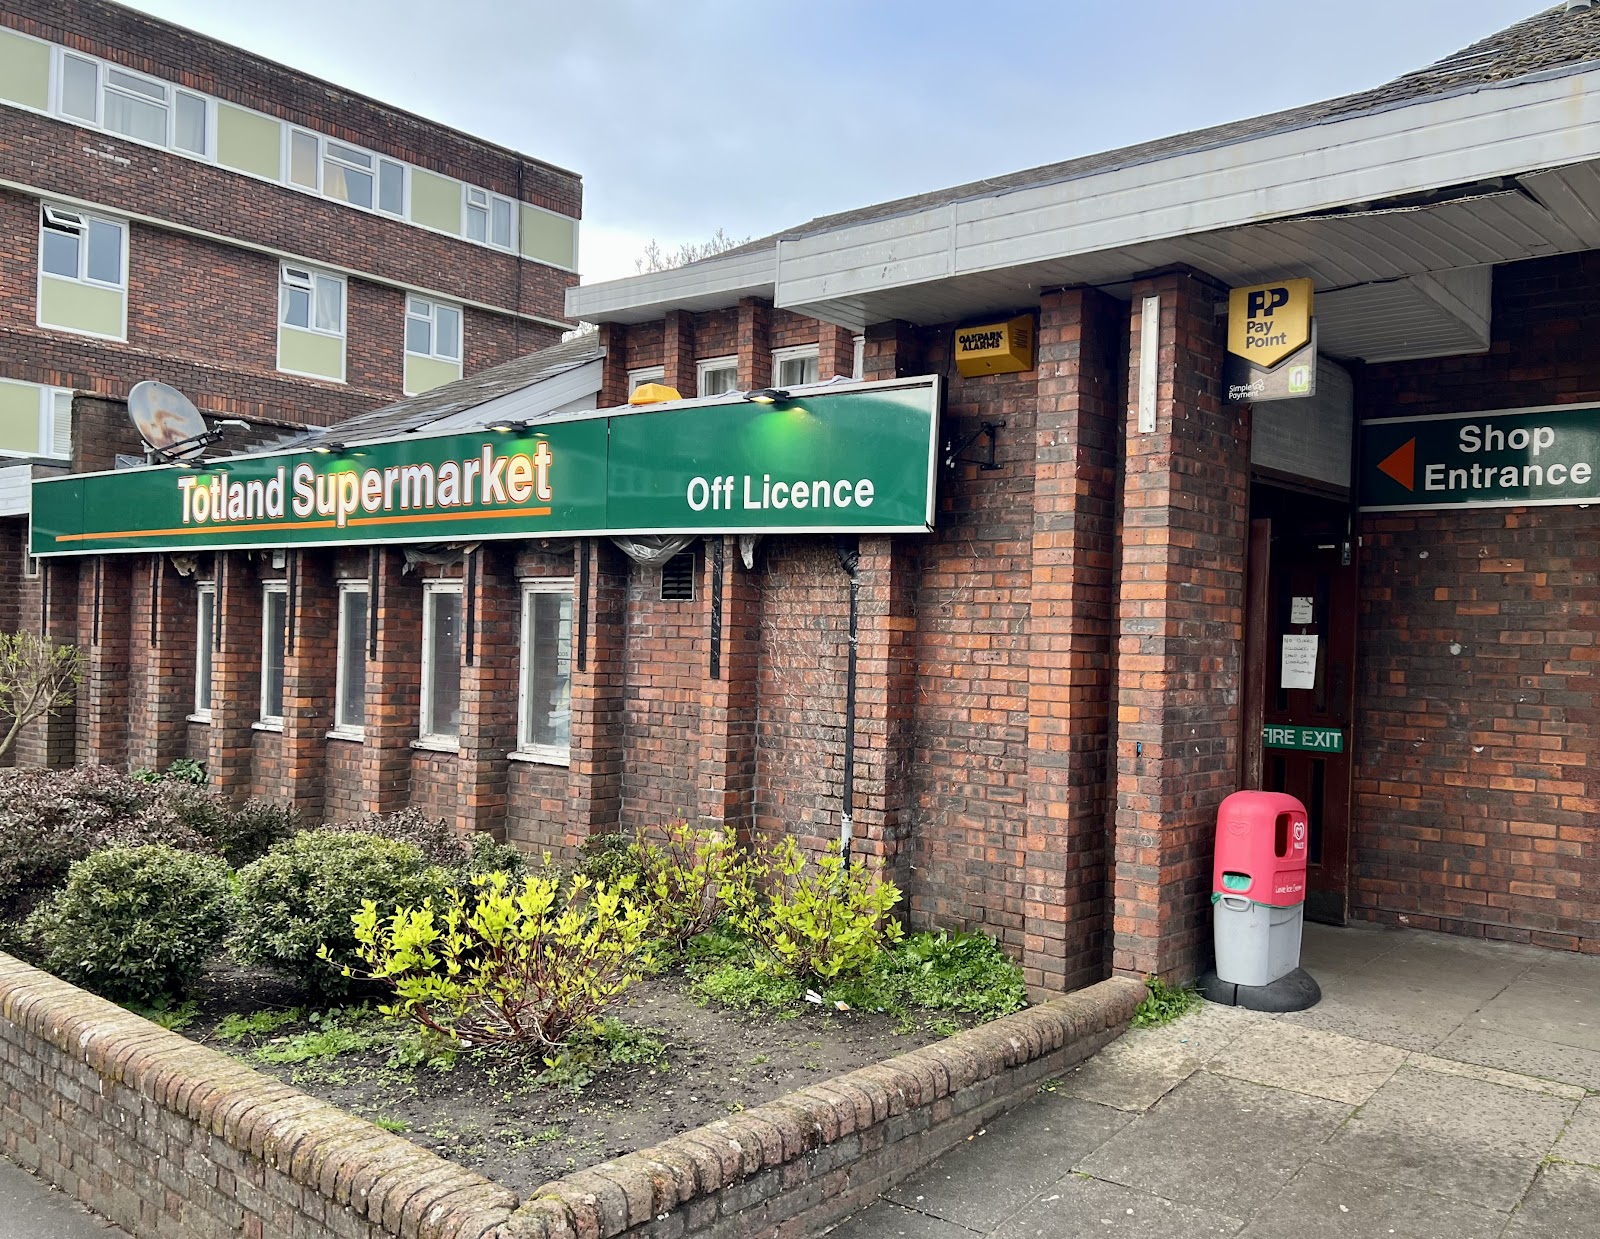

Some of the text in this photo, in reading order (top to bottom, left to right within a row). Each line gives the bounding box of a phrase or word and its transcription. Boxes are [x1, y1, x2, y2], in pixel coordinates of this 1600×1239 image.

[1246, 321, 1273, 335] Pay
[959, 330, 1003, 344] OAKPARK
[962, 339, 1000, 351] ALARMS
[1246, 332, 1286, 349] Point
[1228, 389, 1259, 400] Payment
[1229, 383, 1252, 393] Simple
[1458, 424, 1555, 456] Shop
[177, 440, 552, 528] Totland Supermarket
[1424, 462, 1592, 491] Entrance
[686, 473, 875, 511] Off Licence
[1263, 728, 1342, 748] FIRE EXIT
